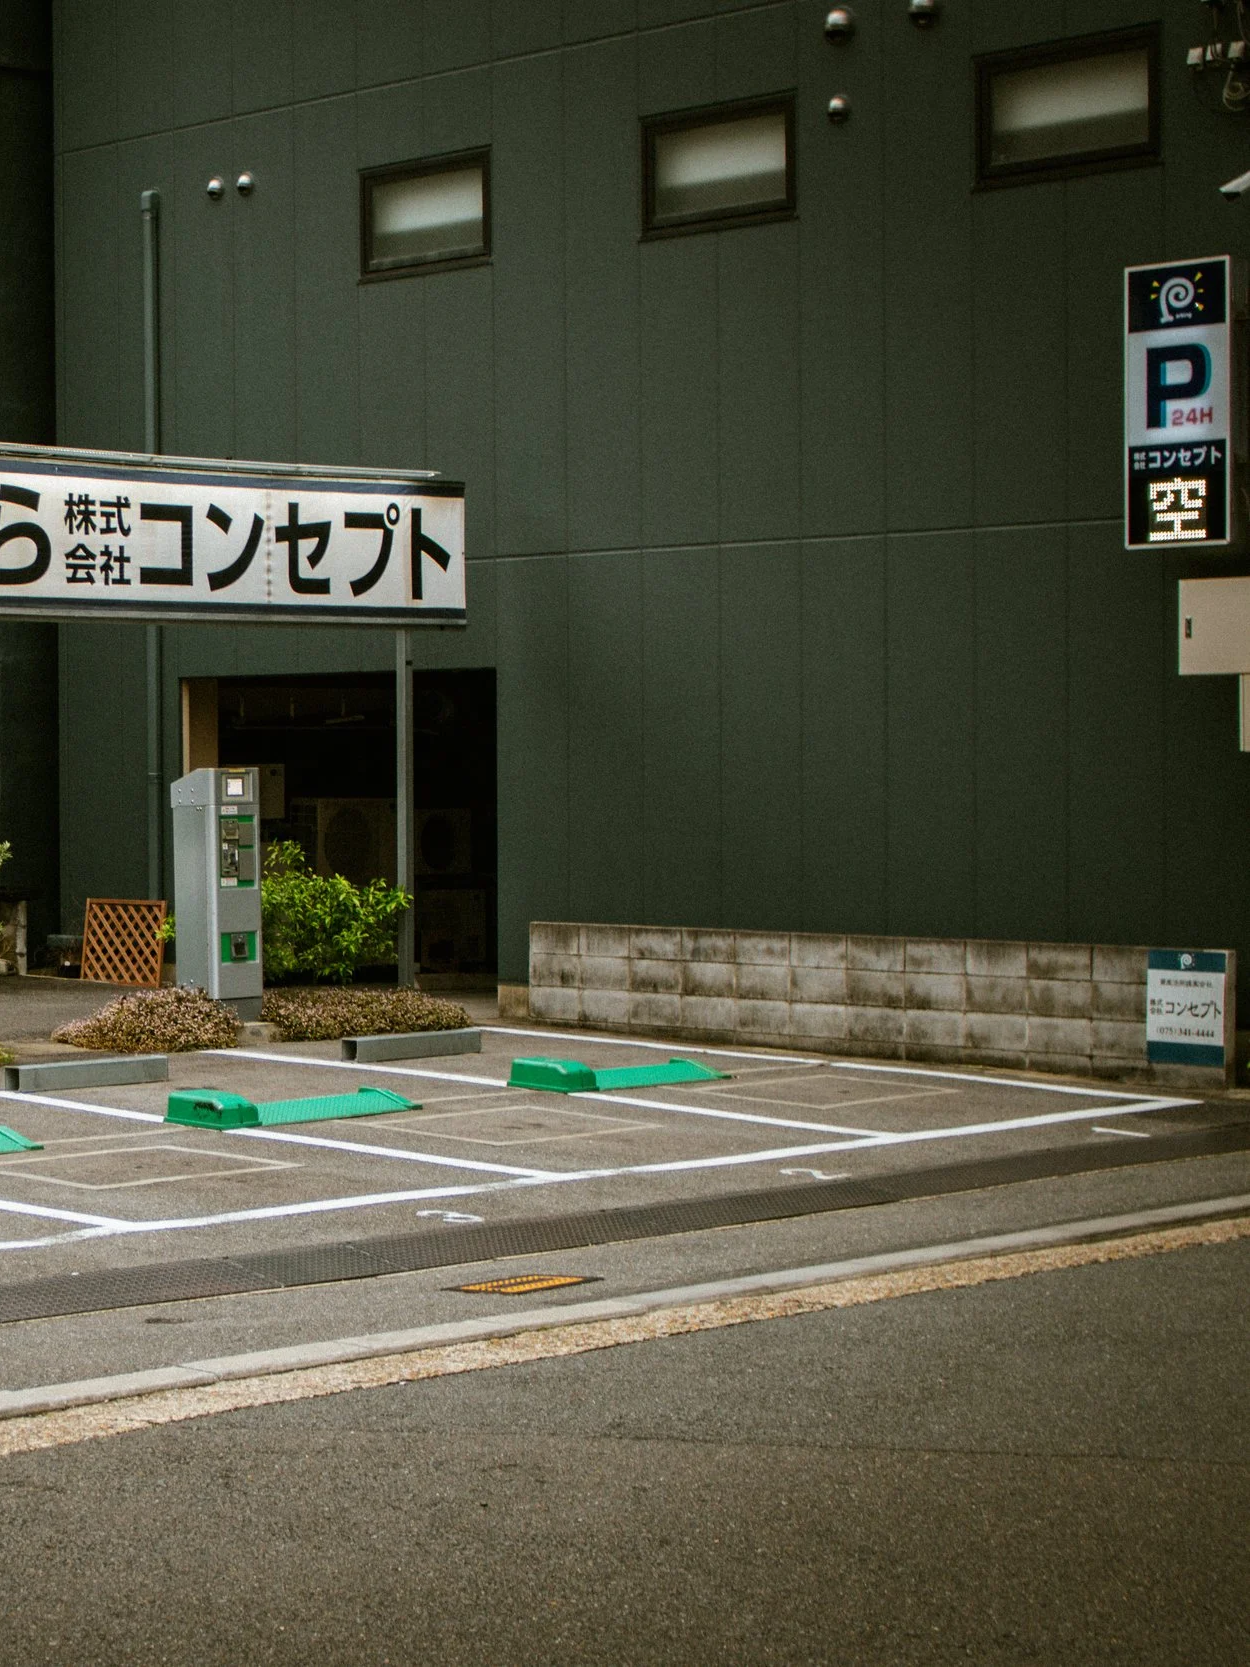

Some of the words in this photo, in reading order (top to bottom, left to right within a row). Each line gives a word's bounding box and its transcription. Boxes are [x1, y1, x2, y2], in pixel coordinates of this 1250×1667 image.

[1146, 343, 1211, 428] P
[1172, 407, 1213, 426] 24H
[1148, 446, 1222, 468] コンセプト
[1149, 478, 1206, 542] 空
[139, 501, 451, 600] コンセプト
[1165, 1000, 1222, 1020] コンセプト
[779, 1168, 852, 1180] 2
